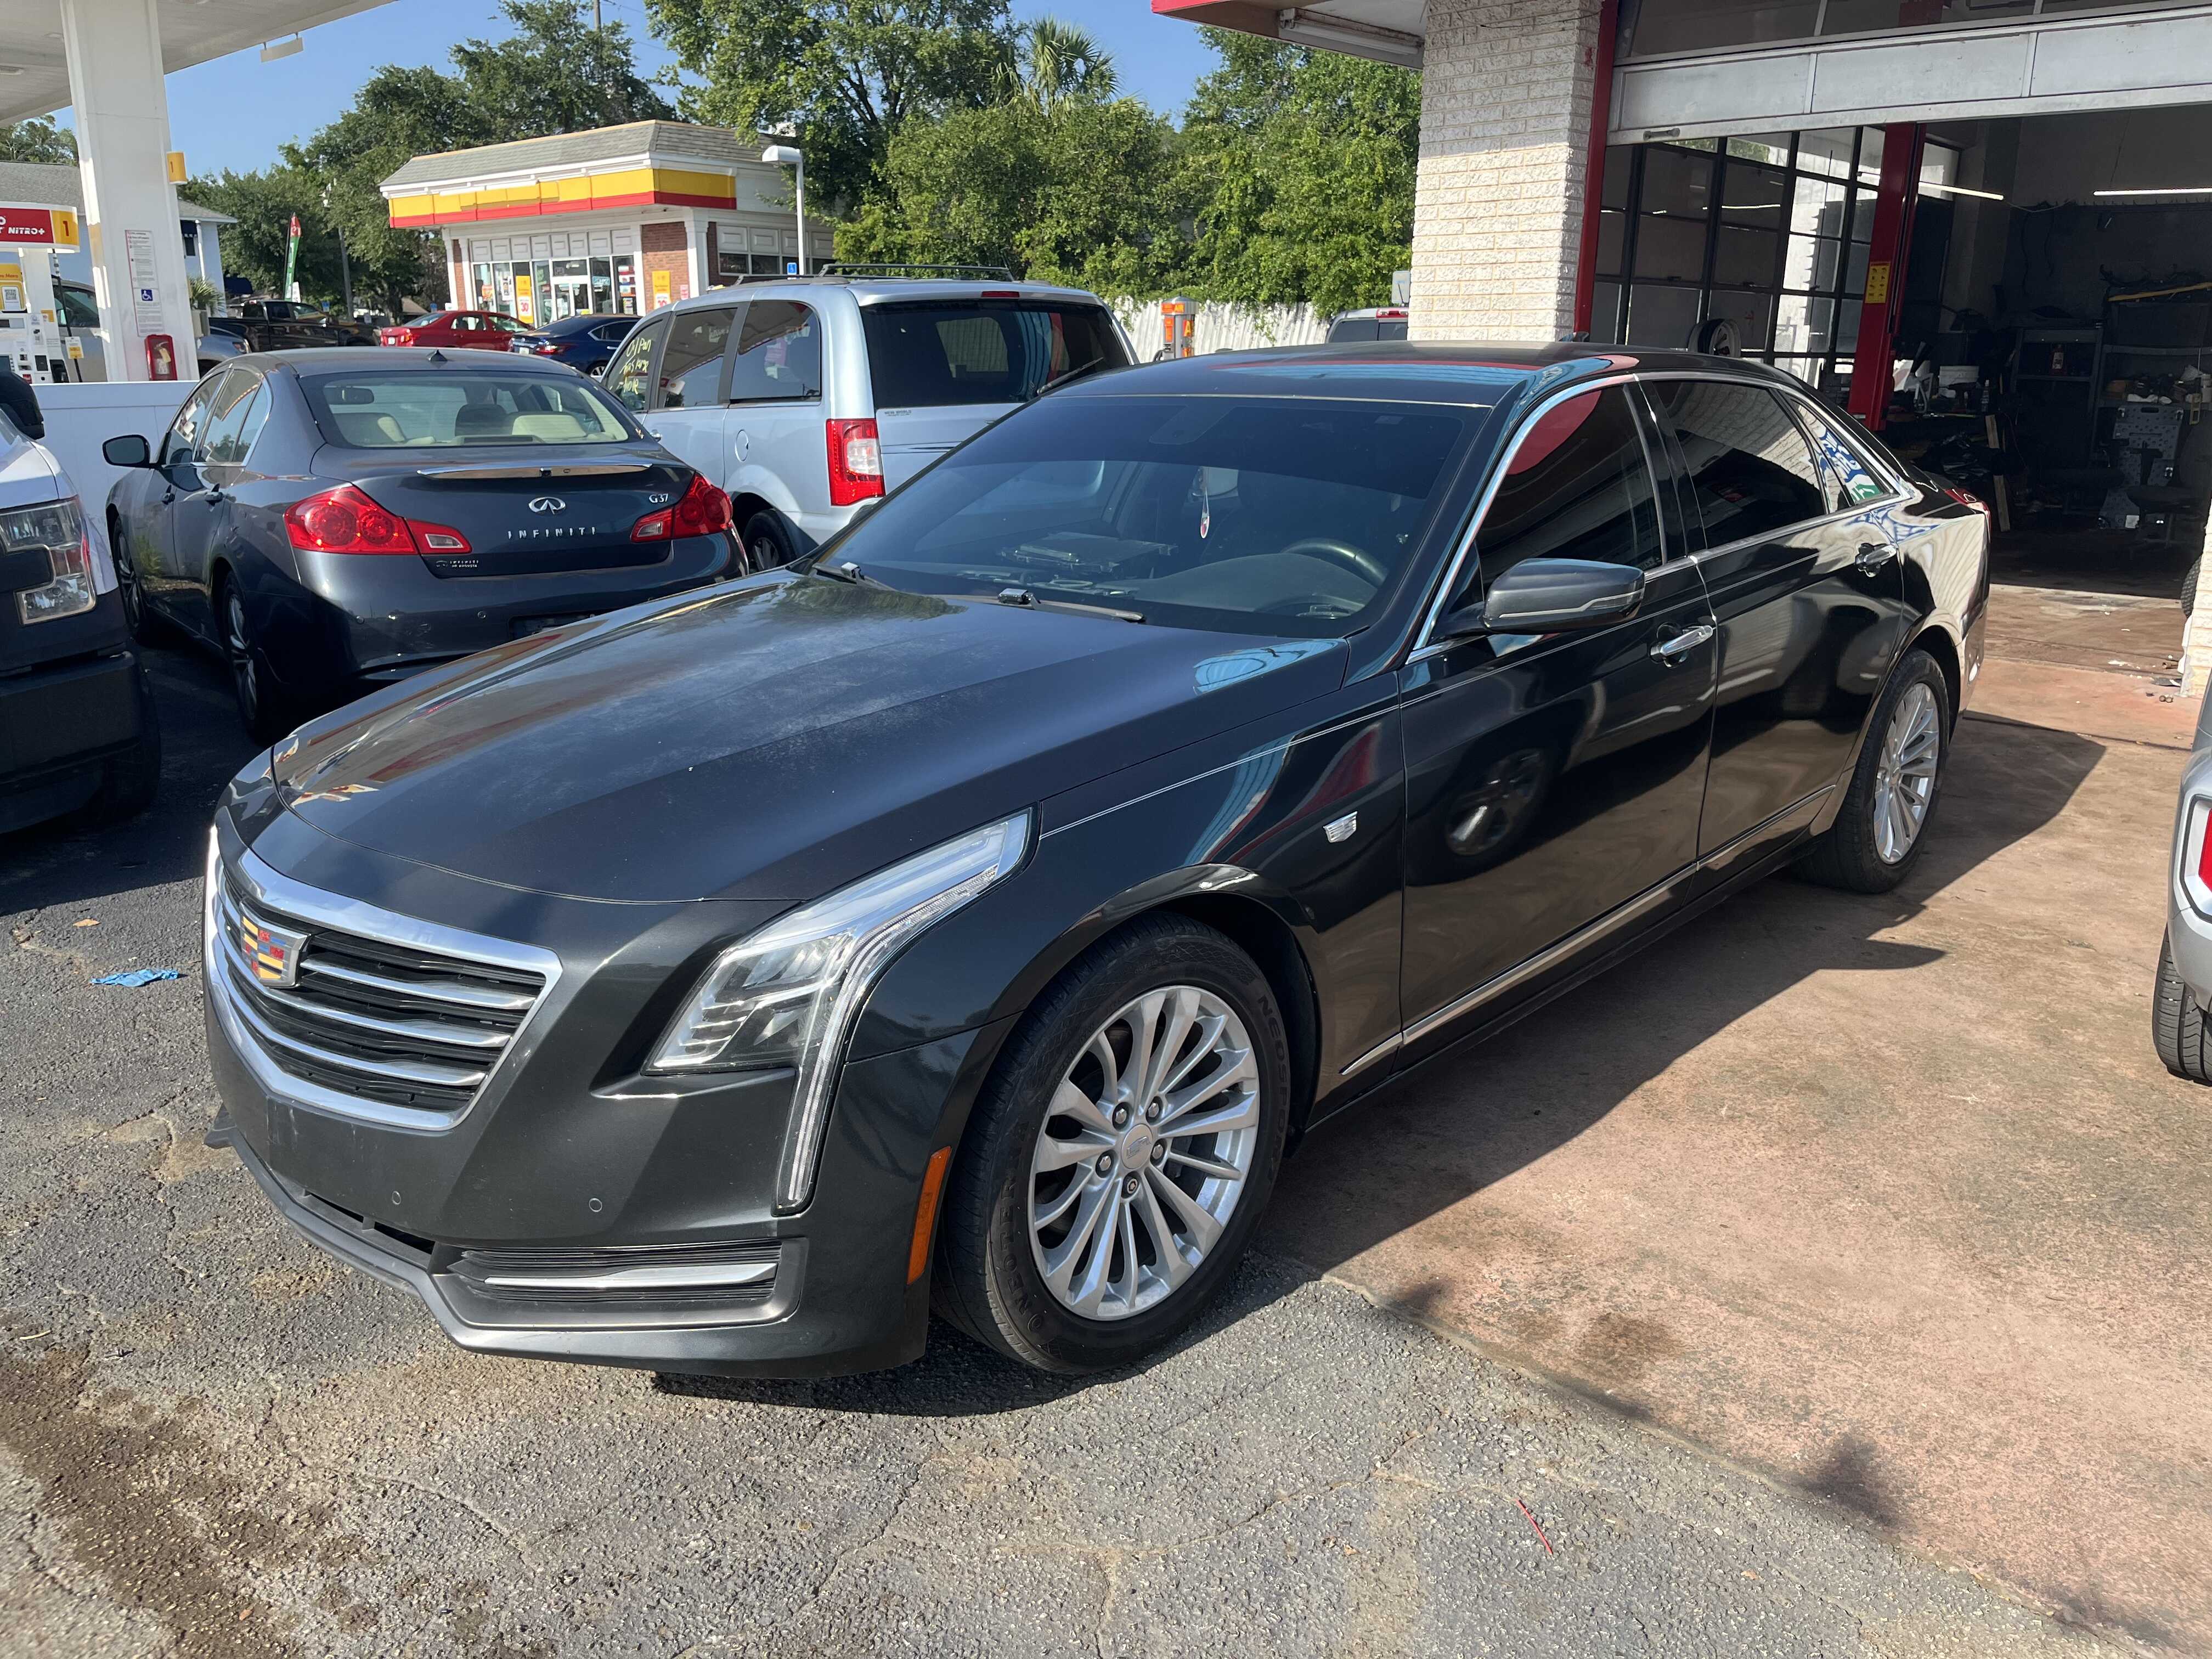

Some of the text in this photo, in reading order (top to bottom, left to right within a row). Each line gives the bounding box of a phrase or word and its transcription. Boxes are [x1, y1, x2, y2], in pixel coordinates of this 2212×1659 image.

[63, 221, 69, 236] 1
[648, 493, 669, 503] G37
[508, 526, 595, 539] INFINITI
